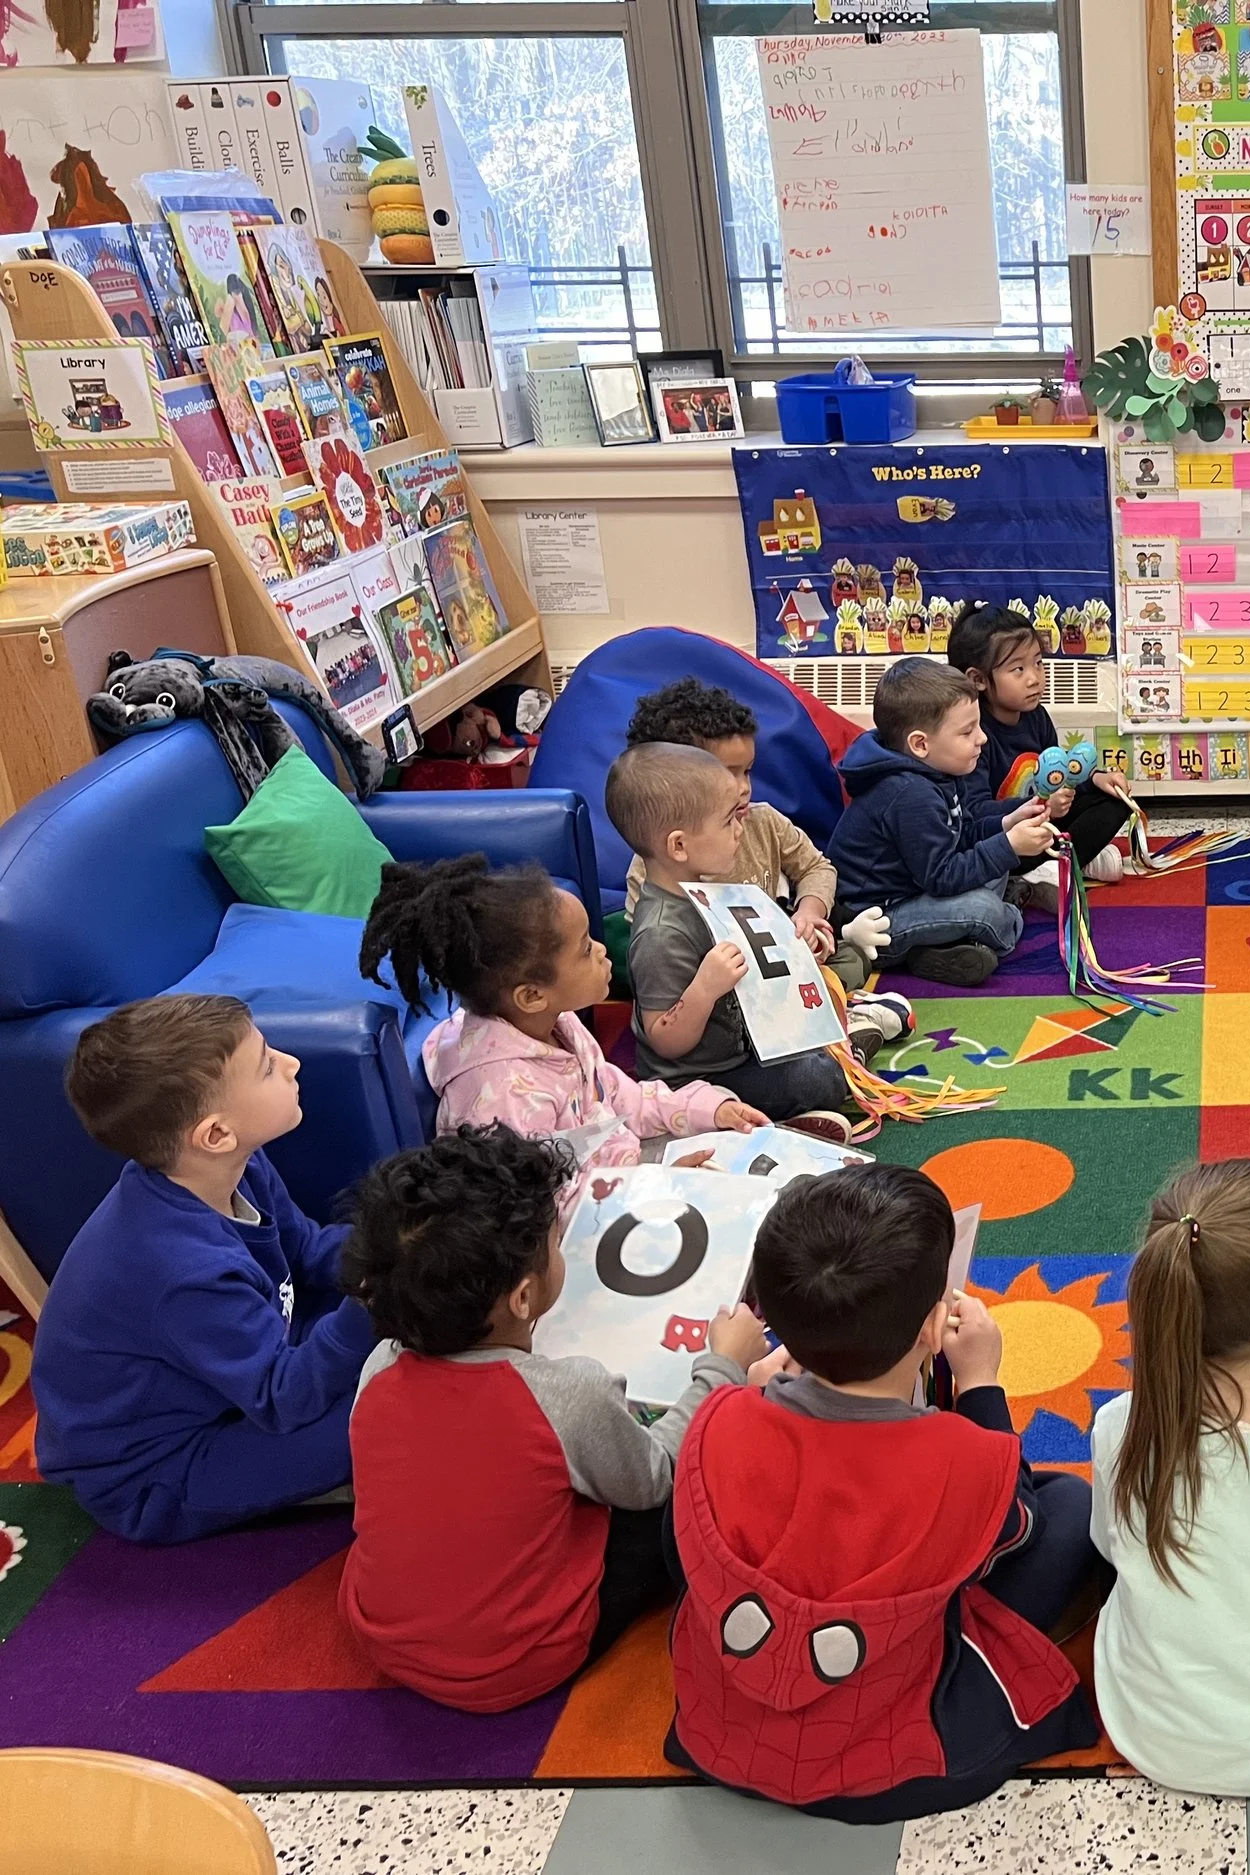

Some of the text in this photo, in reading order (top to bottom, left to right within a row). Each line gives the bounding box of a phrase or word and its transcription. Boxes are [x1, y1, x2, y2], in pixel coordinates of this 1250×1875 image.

[755, 31, 945, 52] Thursday, 2023
[246, 128, 264, 187] Exercise
[276, 139, 294, 176] Balls
[421, 140, 437, 178] Trees
[1070, 193, 1086, 201] How
[1089, 195, 1109, 204] many
[1111, 193, 1127, 203] kids
[1083, 207, 1130, 218] here today?
[1092, 214, 1120, 247] 15
[1211, 222, 1217, 238] 1
[60, 357, 106, 369] Library
[301, 382, 331, 399] Animal
[311, 396, 339, 414] Homes
[871, 464, 981, 481] Who's Here?
[1209, 463, 1223, 484] 2
[219, 482, 270, 503] Casey
[340, 494, 364, 510] The Tiny
[349, 506, 363, 519] Seed
[525, 511, 588, 521] Library Center
[1207, 553, 1219, 573] 2
[362, 576, 393, 598] Our Class
[296, 590, 349, 618] Our Friendship Book
[1209, 601, 1220, 621] 2
[903, 632, 925, 641] Chloe
[408, 628, 433, 681] 5
[1206, 644, 1245, 665] 2 3
[1218, 691, 1229, 711] 2
[1102, 749, 1125, 765] Ff
[1139, 750, 1165, 769] Gg
[1178, 749, 1203, 766] Hh
[1220, 748, 1236, 764] Ii
[726, 904, 791, 980] E
[1067, 1067, 1185, 1102] Kk
